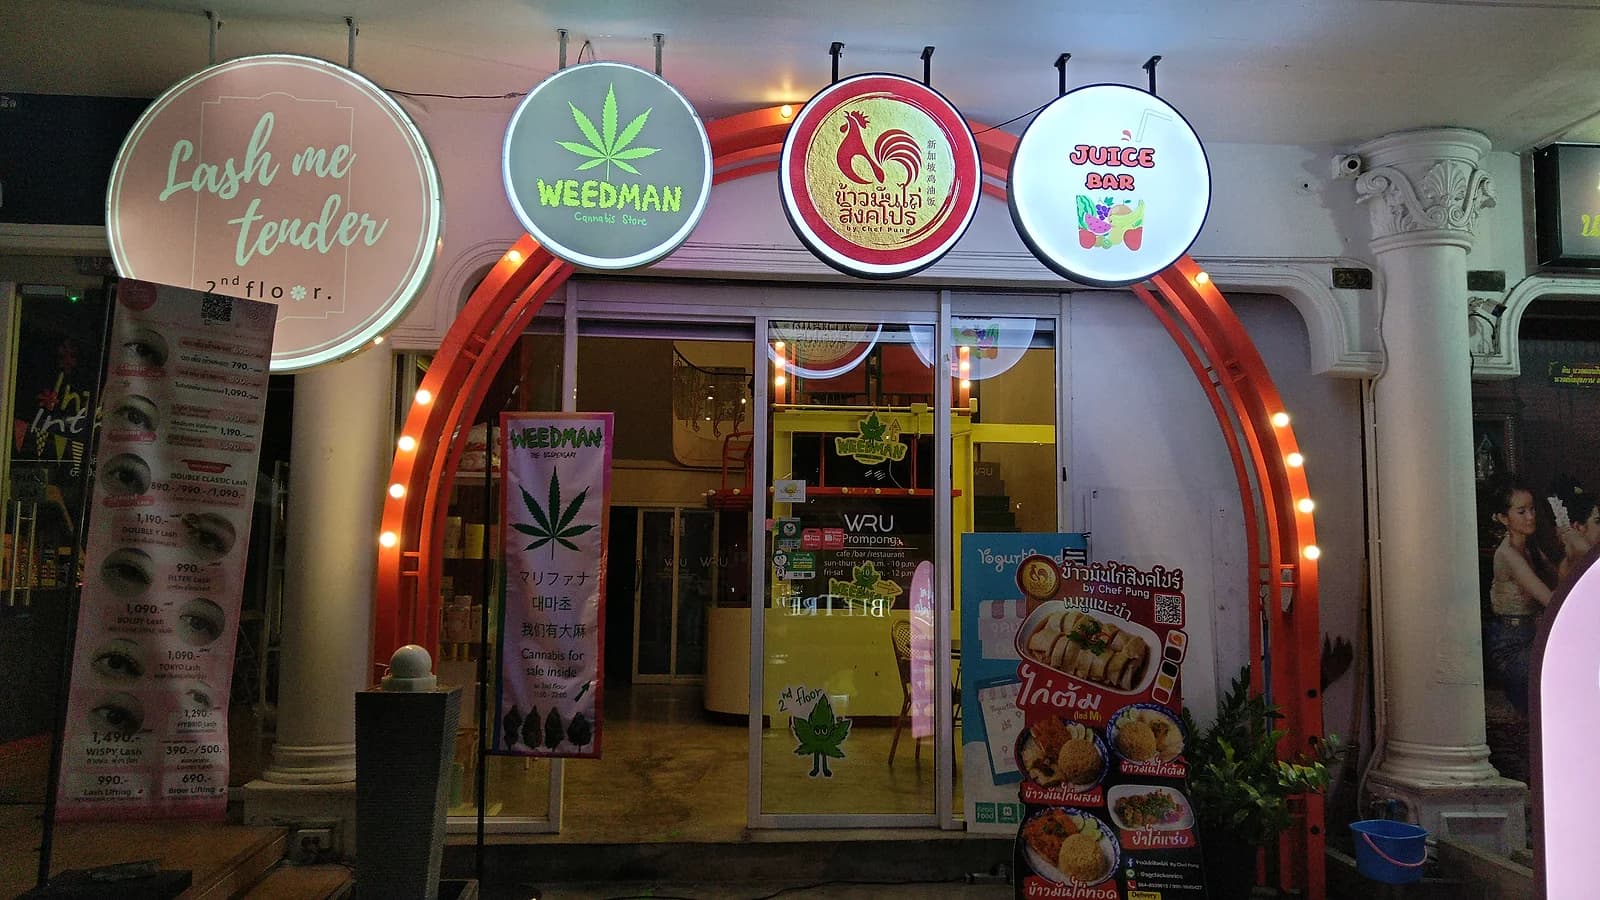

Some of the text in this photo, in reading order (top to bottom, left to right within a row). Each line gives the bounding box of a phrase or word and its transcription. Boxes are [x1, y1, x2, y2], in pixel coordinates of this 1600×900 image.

[159, 112, 356, 201] Lash me
[1069, 145, 1156, 168] JUICE
[1085, 172, 1135, 191] BAR
[536, 178, 682, 213] WEEDMAN
[574, 211, 648, 226] Cannabis Store
[227, 193, 388, 267] tender
[846, 225, 857, 233] by
[510, 426, 602, 449] WEEDMAN
[170, 472, 199, 481] DOUBLE
[843, 513, 894, 533] WRU
[843, 533, 897, 547] Prompong
[836, 550, 851, 558] cafe
[520, 571, 589, 586] マリファナ
[823, 569, 843, 577] fri-sat
[1062, 561, 1181, 590] ข้าวมันไก่สิงคโปร์
[1083, 584, 1095, 594] by
[1125, 587, 1150, 599] Pung
[532, 595, 572, 612] 대마초
[1063, 596, 1132, 622] เมนูแนะนำ
[521, 622, 586, 639] 我们有大麻
[521, 648, 584, 661] Cannabis for
[526, 665, 577, 678] sale inside
[1020, 663, 1102, 710] ไก่ต้ม
[779, 687, 822, 712] 2nd floor
[1121, 757, 1186, 776] ข้าวมันไก่ต้ม
[1025, 781, 1101, 803] ข้าวมันไก่ผสม
[1029, 875, 1118, 900] ข้าวมันไก่ทอด
